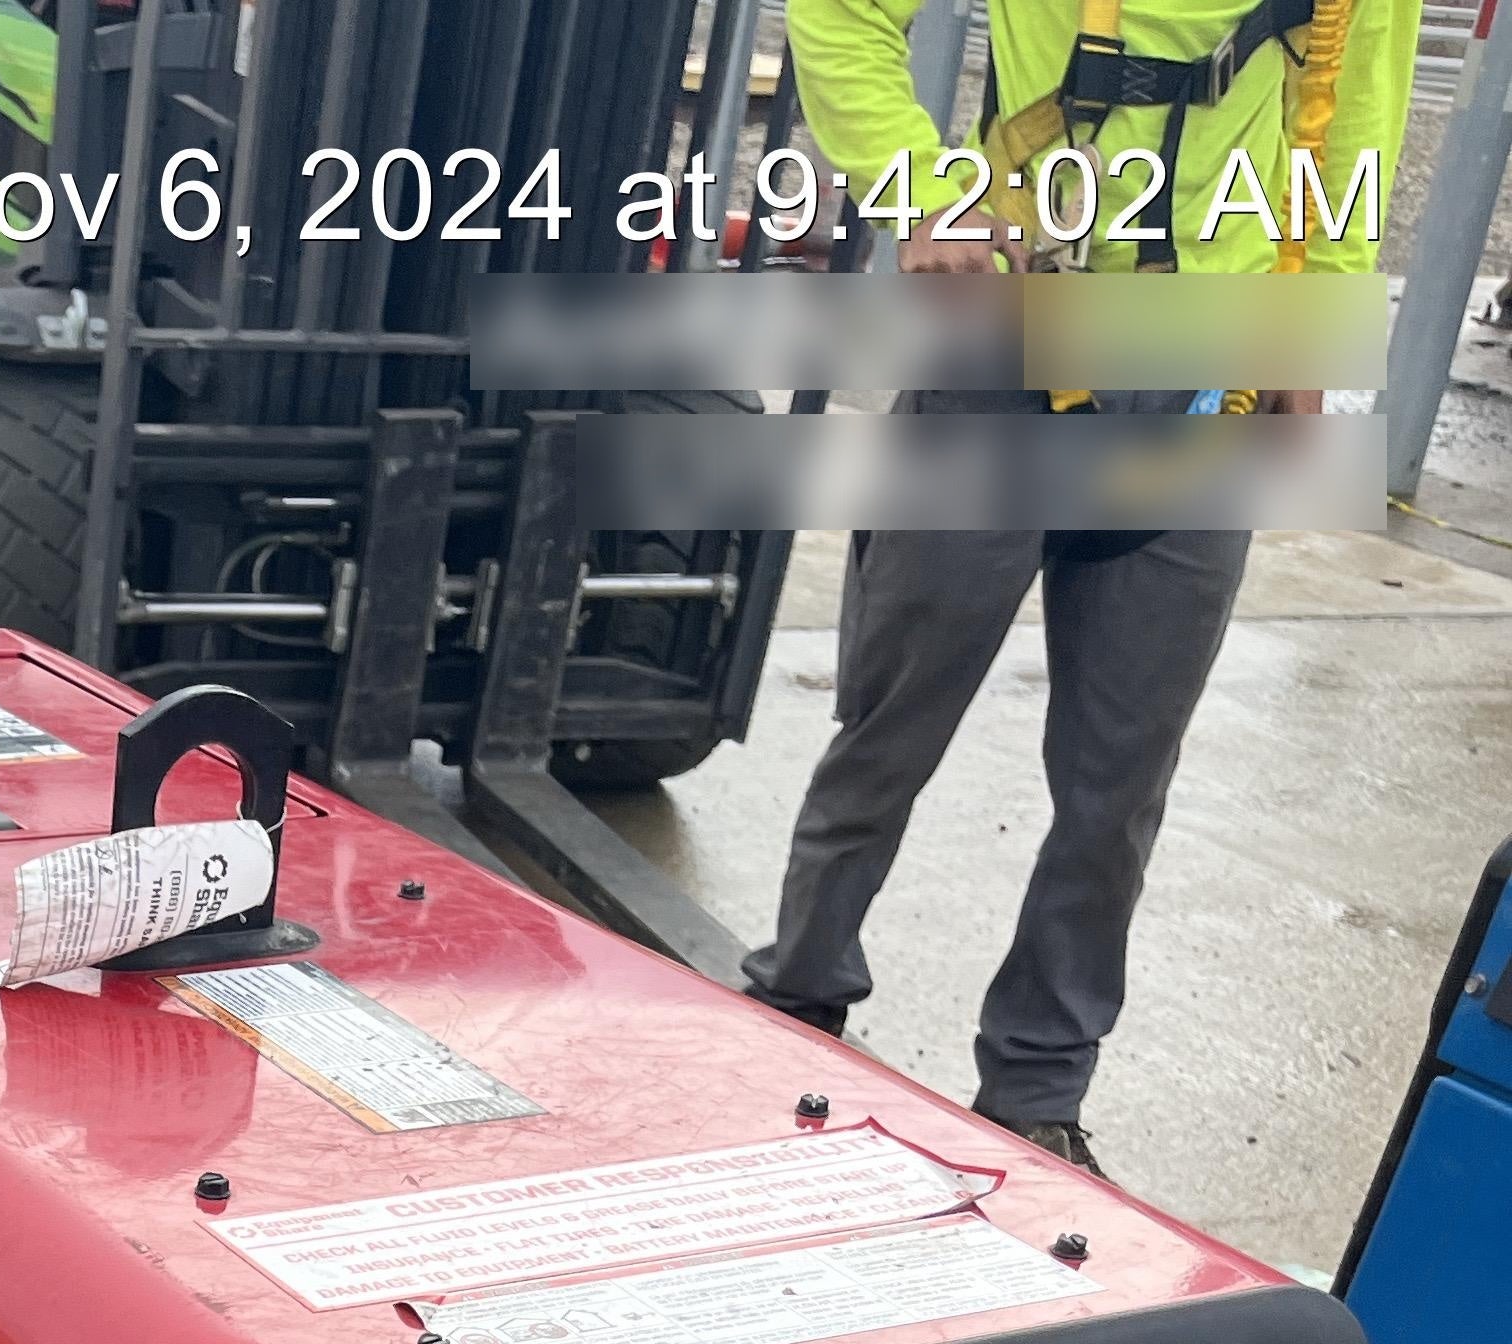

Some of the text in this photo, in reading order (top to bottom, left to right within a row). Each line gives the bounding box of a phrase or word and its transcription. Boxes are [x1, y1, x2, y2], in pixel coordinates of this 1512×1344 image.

[144, 877, 163, 927] THINK
[282, 1243, 363, 1266] CHECK
[364, 1236, 404, 1255] ALL
[407, 1224, 480, 1248] FLUID
[481, 1212, 551, 1237] LEVELS
[582, 1196, 670, 1223] GREASE
[668, 1189, 730, 1211] DAILY
[733, 1178, 809, 1202] BEFORE
[808, 1165, 885, 1188] START
[883, 1160, 908, 1176] UP
[385, 1133, 890, 1219] CUSTOMER RESPONSIBILITY
[316, 1275, 422, 1302] DAMAGE
[422, 1271, 454, 1288] TO
[456, 1249, 590, 1279] EQUIPMENT
[606, 1233, 702, 1256] BATTERY
[704, 1209, 858, 1241] MAINTENANCE
[345, 1246, 482, 1276] INSURANCE
[494, 1235, 551, 1255] FLAT
[552, 1225, 621, 1245] TIRES
[634, 1215, 685, 1234] TIRE
[685, 1200, 781, 1225] DAMAGE
